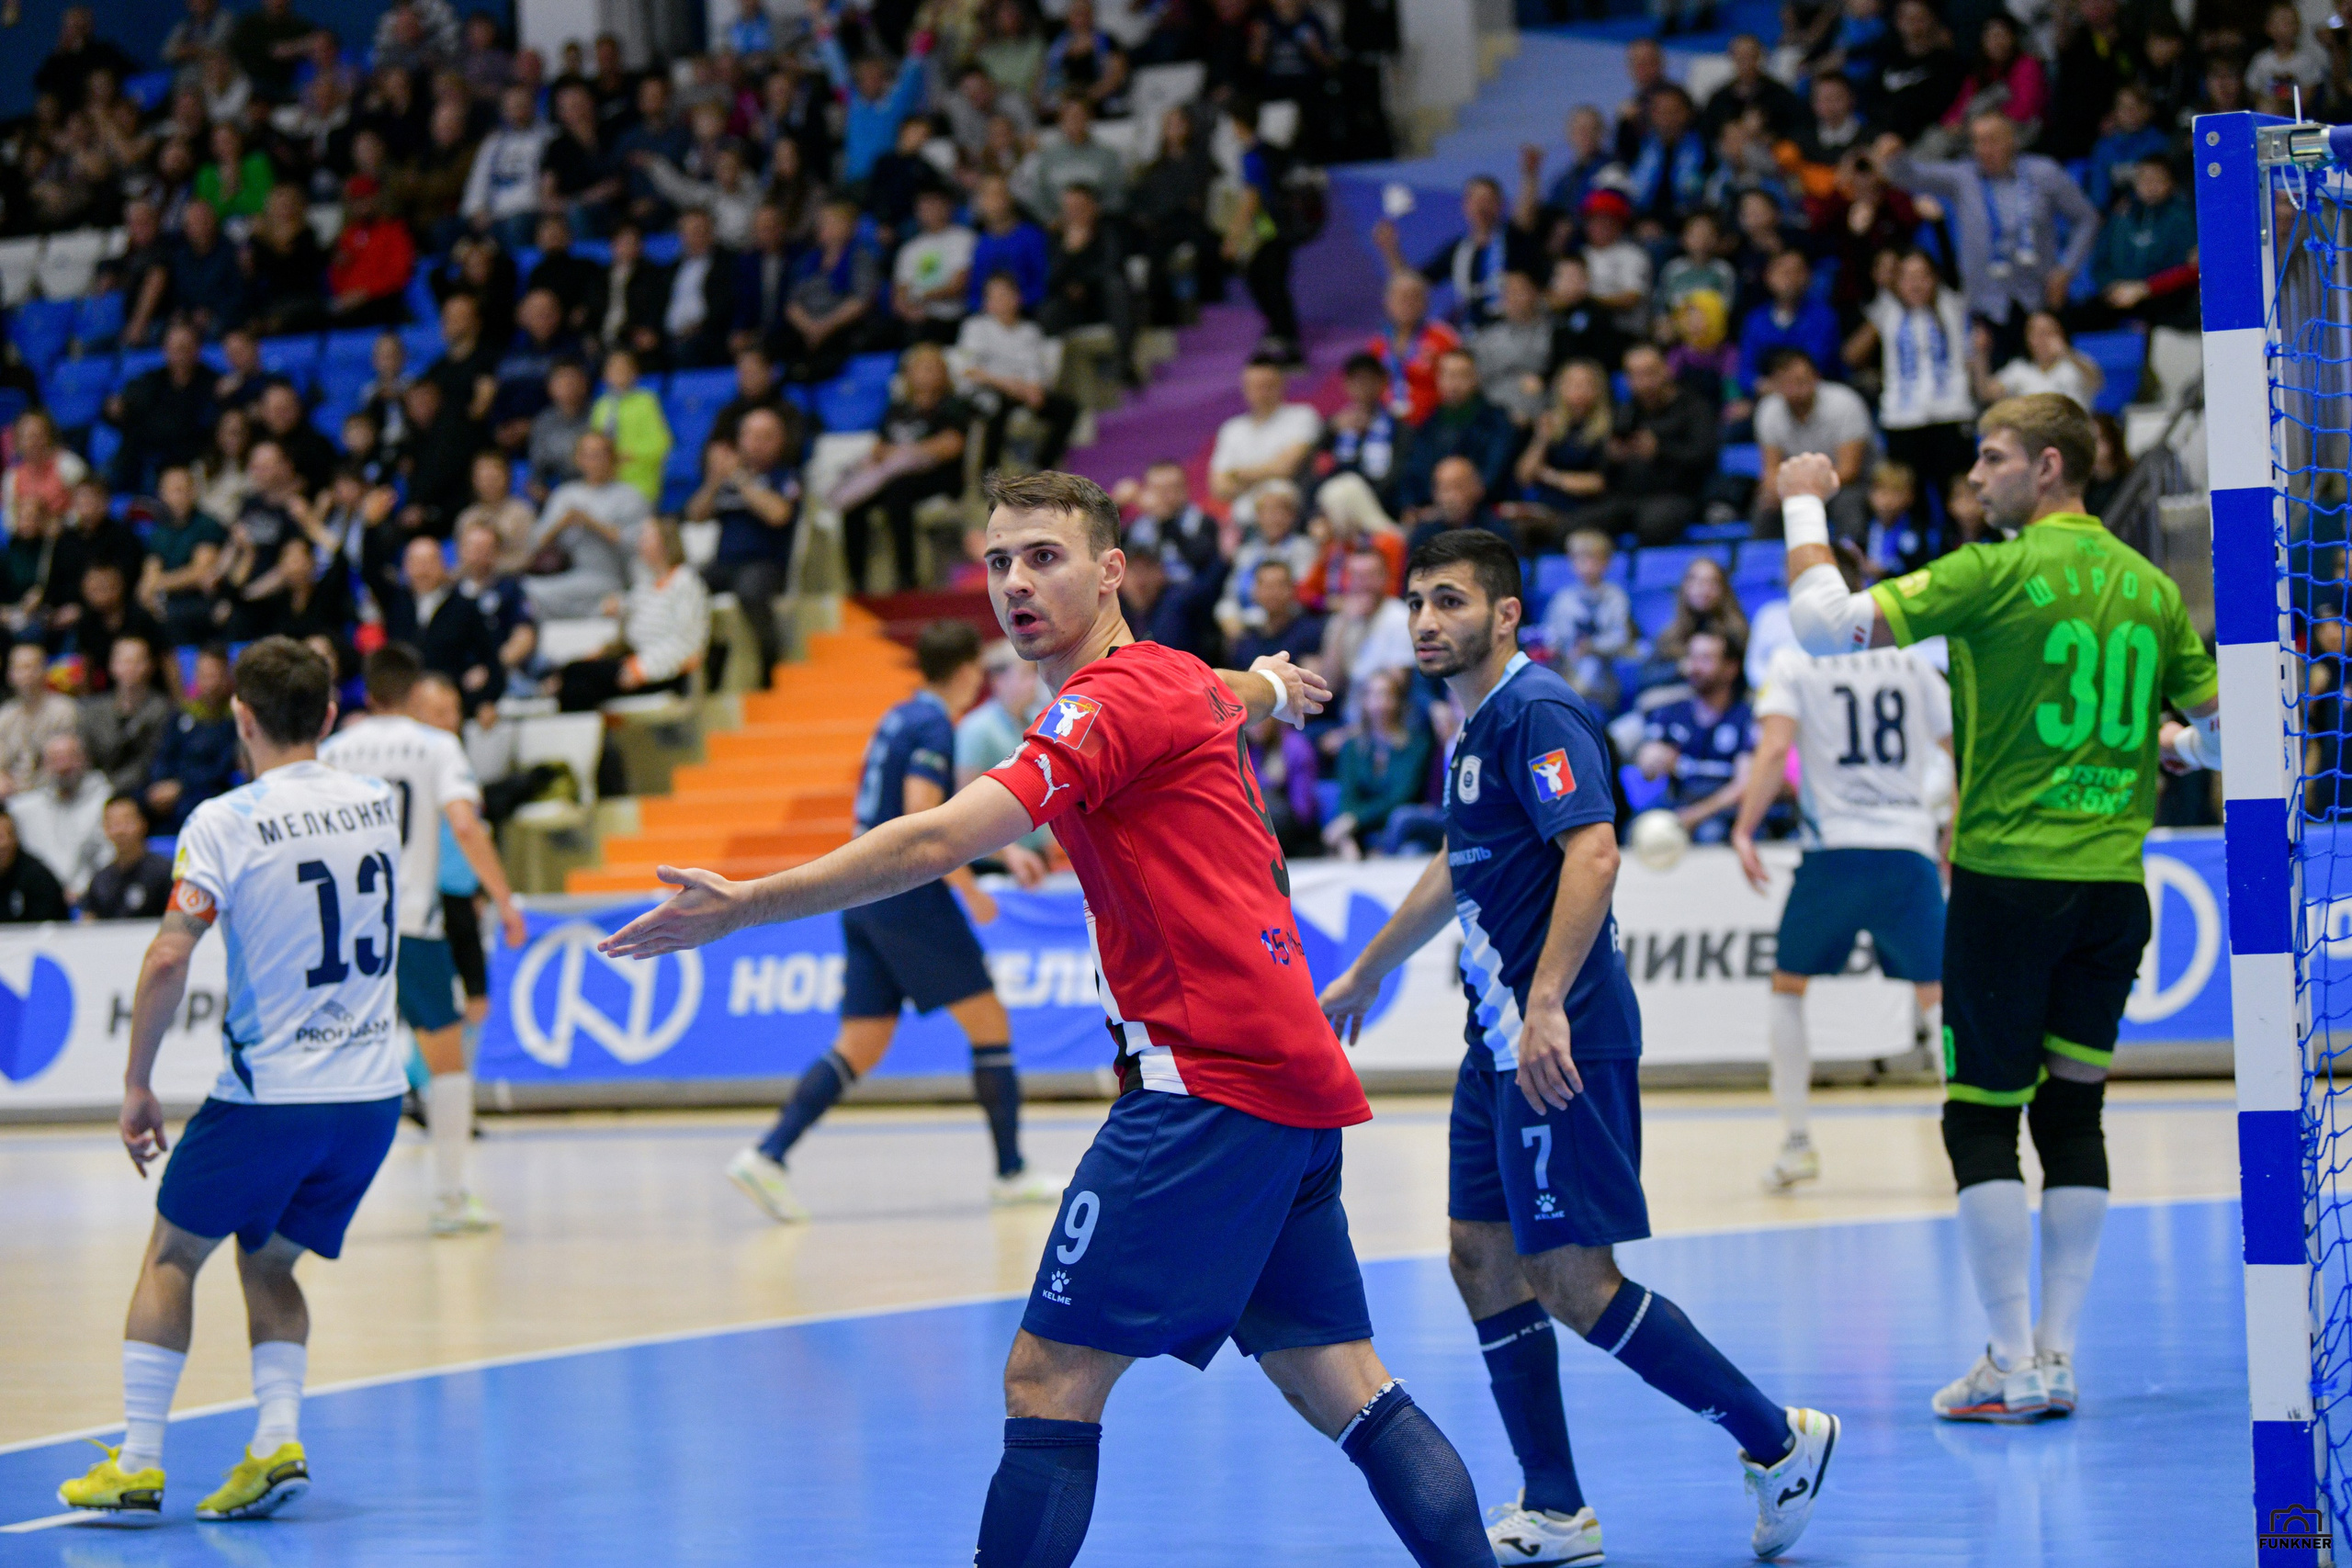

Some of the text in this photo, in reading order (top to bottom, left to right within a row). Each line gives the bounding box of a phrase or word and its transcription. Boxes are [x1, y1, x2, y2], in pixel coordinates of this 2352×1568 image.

[2036, 617, 2158, 751] 30
[1833, 684, 1906, 769] 18
[297, 849, 395, 989] 13
[1521, 1124, 1553, 1190] 7
[1057, 1190, 1100, 1265] 9
[1042, 1289, 1072, 1305] KELME
